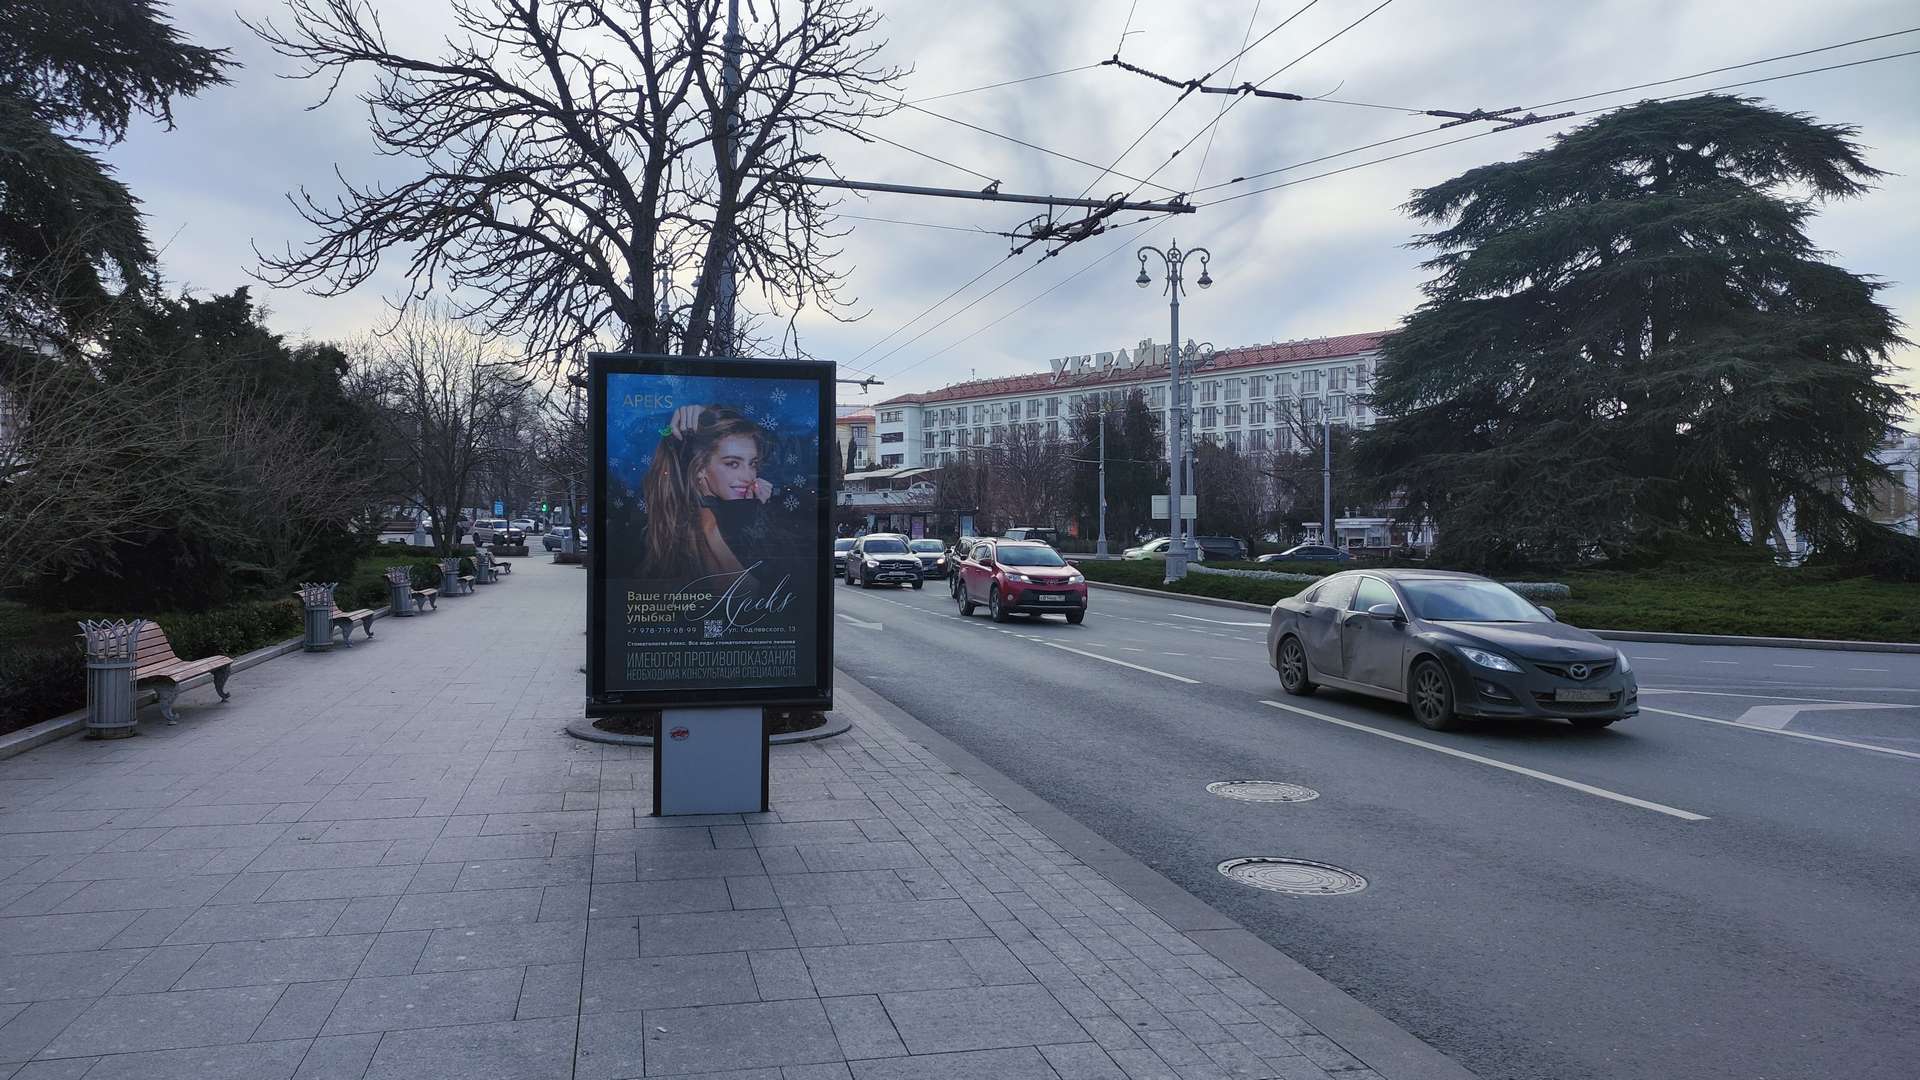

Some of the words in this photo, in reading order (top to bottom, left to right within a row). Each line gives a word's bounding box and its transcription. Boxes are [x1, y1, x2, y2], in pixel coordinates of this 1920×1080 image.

[623, 393, 673, 408] APEKS
[627, 591, 660, 601] Ваше
[663, 592, 712, 601] главное
[626, 602, 697, 614] украшение
[626, 612, 675, 624] улыбка!
[626, 651, 681, 668] ИМЕЮТСЯ
[684, 649, 796, 667] ПРОТИВОПОКАЗАНИЯ
[626, 668, 680, 681] НЕОБХОДИМА
[682, 666, 740, 680] КОНСУЛЬТАЦИЯ
[741, 665, 796, 679] СПЕЦИАЛИСТА
